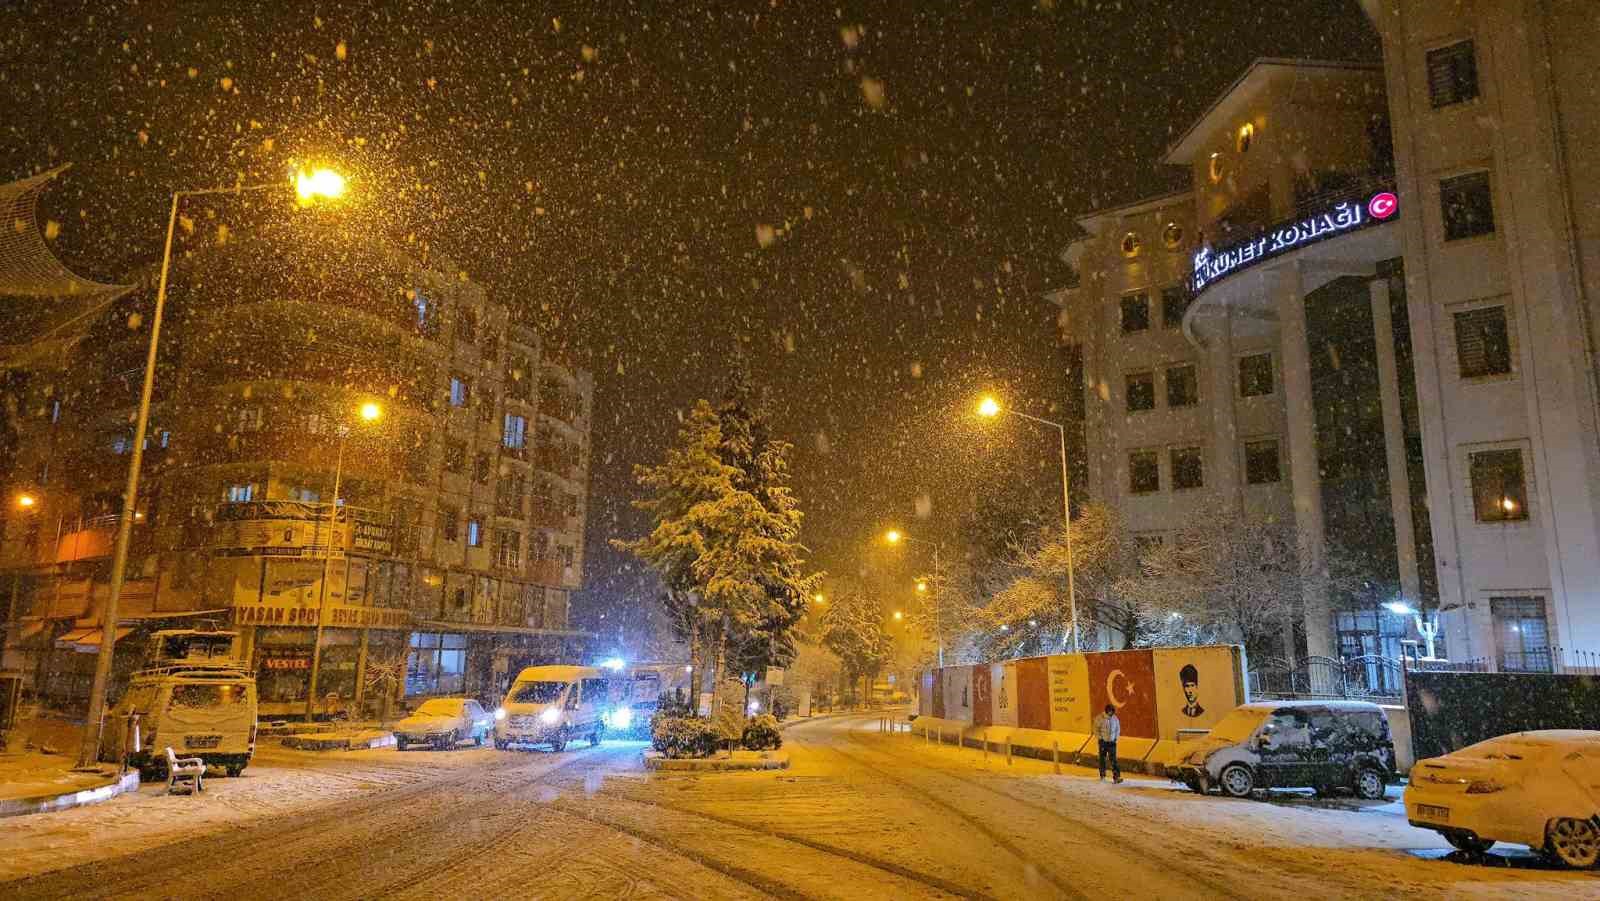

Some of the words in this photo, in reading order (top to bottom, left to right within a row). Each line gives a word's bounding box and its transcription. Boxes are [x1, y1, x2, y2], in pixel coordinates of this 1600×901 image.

[1270, 202, 1361, 251] KONAĞI
[239, 606, 285, 623] YASAN
[266, 658, 309, 669] VESTEL
